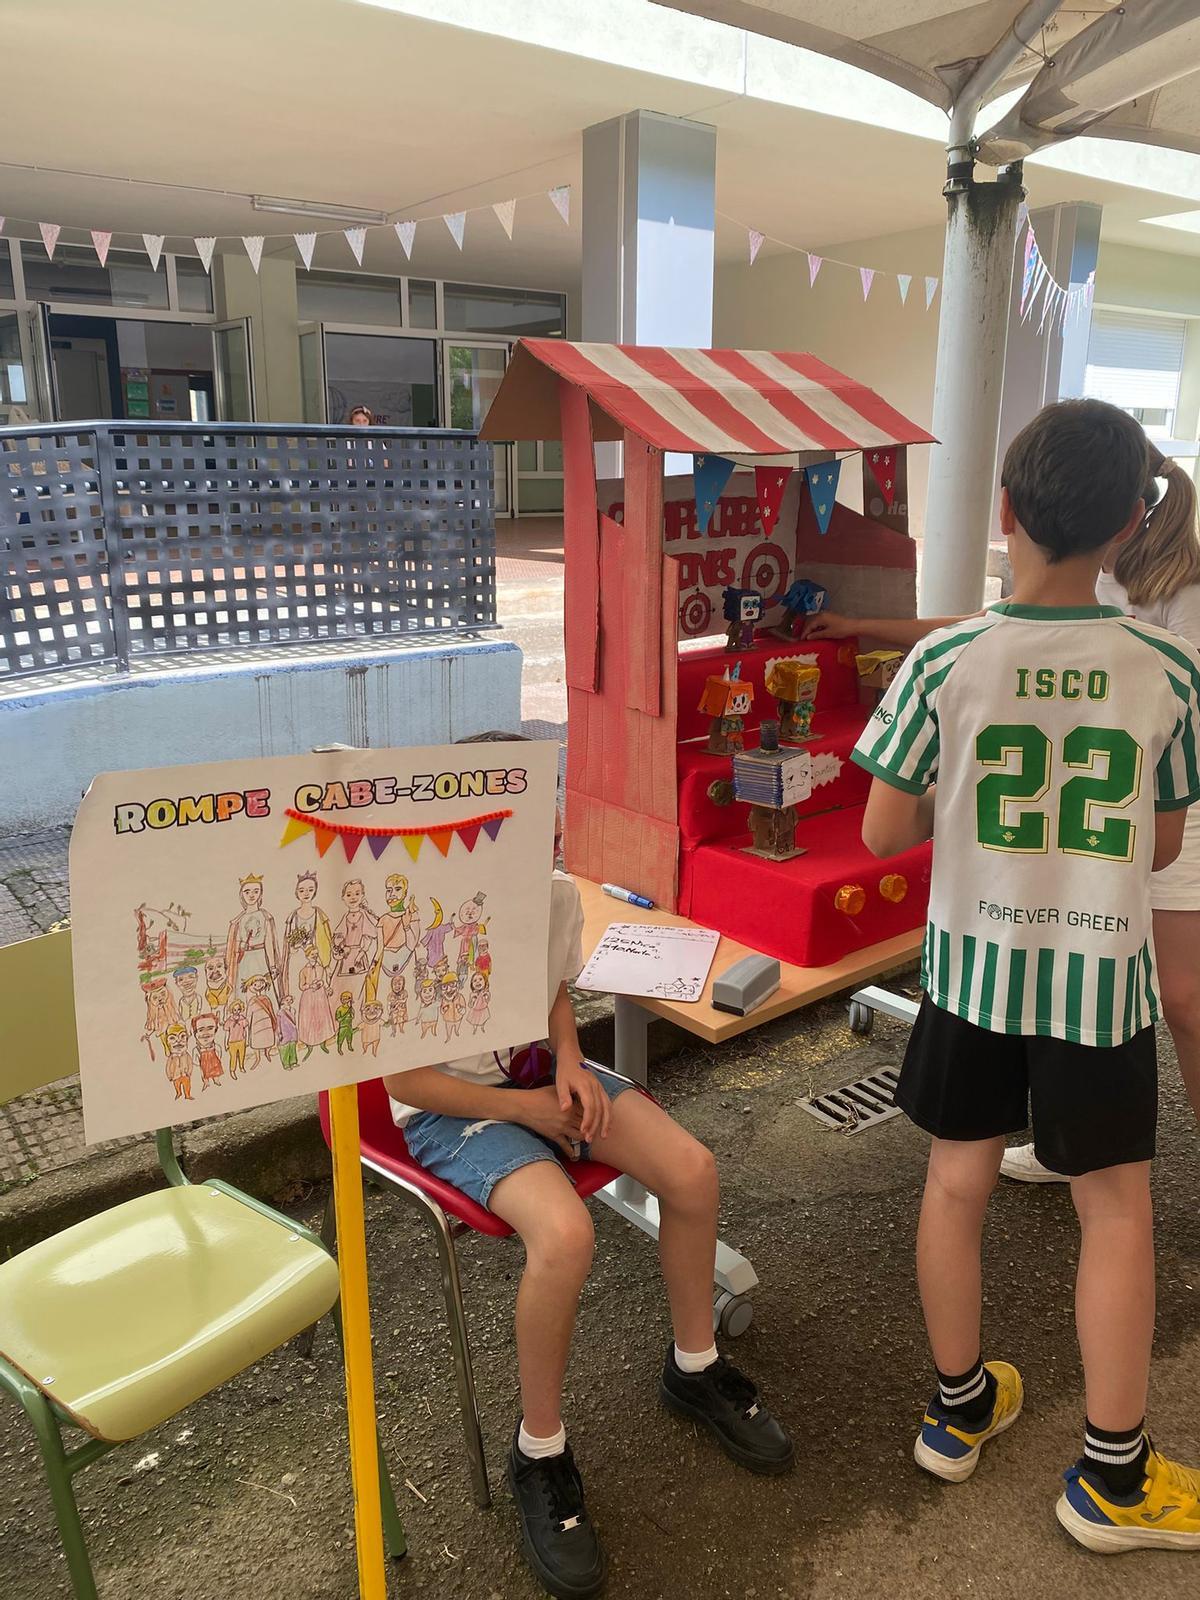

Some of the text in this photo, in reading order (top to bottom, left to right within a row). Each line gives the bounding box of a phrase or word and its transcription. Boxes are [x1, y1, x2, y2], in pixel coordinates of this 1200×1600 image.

[1016, 668, 1109, 700] ISCO
[114, 768, 529, 834] ROMPE CABE-ZONES
[975, 724, 1143, 863] 22
[978, 900, 1129, 932] FOREVER GREEN
